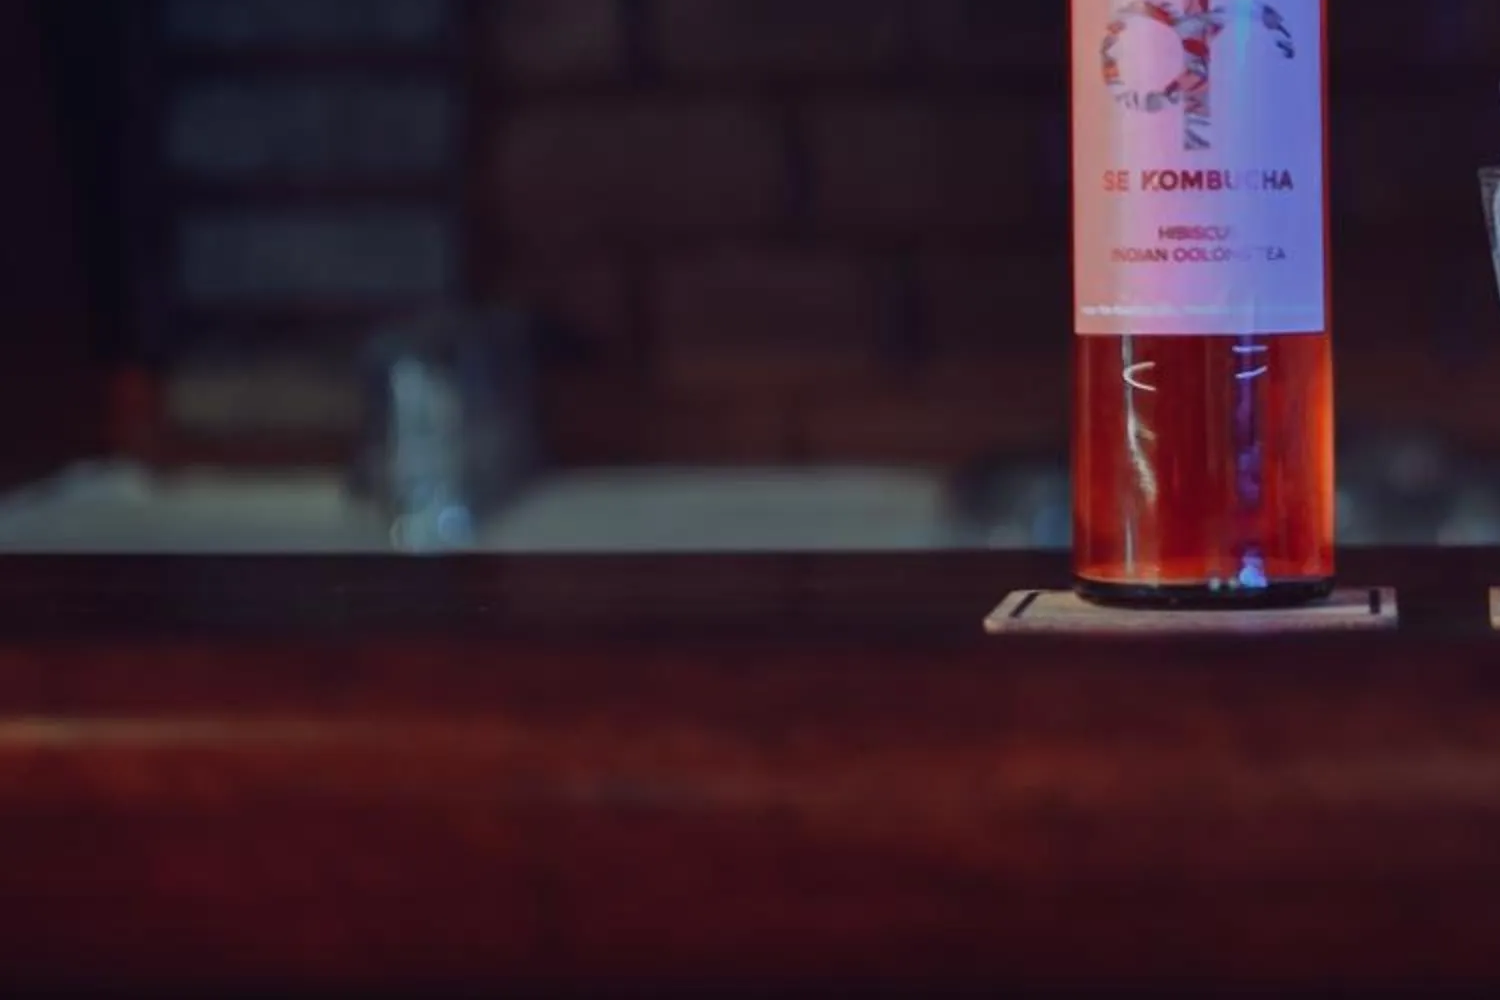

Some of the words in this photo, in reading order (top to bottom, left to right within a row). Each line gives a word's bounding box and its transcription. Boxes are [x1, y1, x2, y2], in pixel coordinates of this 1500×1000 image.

[1102, 169, 1129, 191] SE
[1141, 168, 1294, 191] KOMBUCHA
[1157, 225, 1237, 241] HIBISCU
[1110, 248, 1168, 262] INDIAN
[1172, 247, 1251, 262] OOLO
